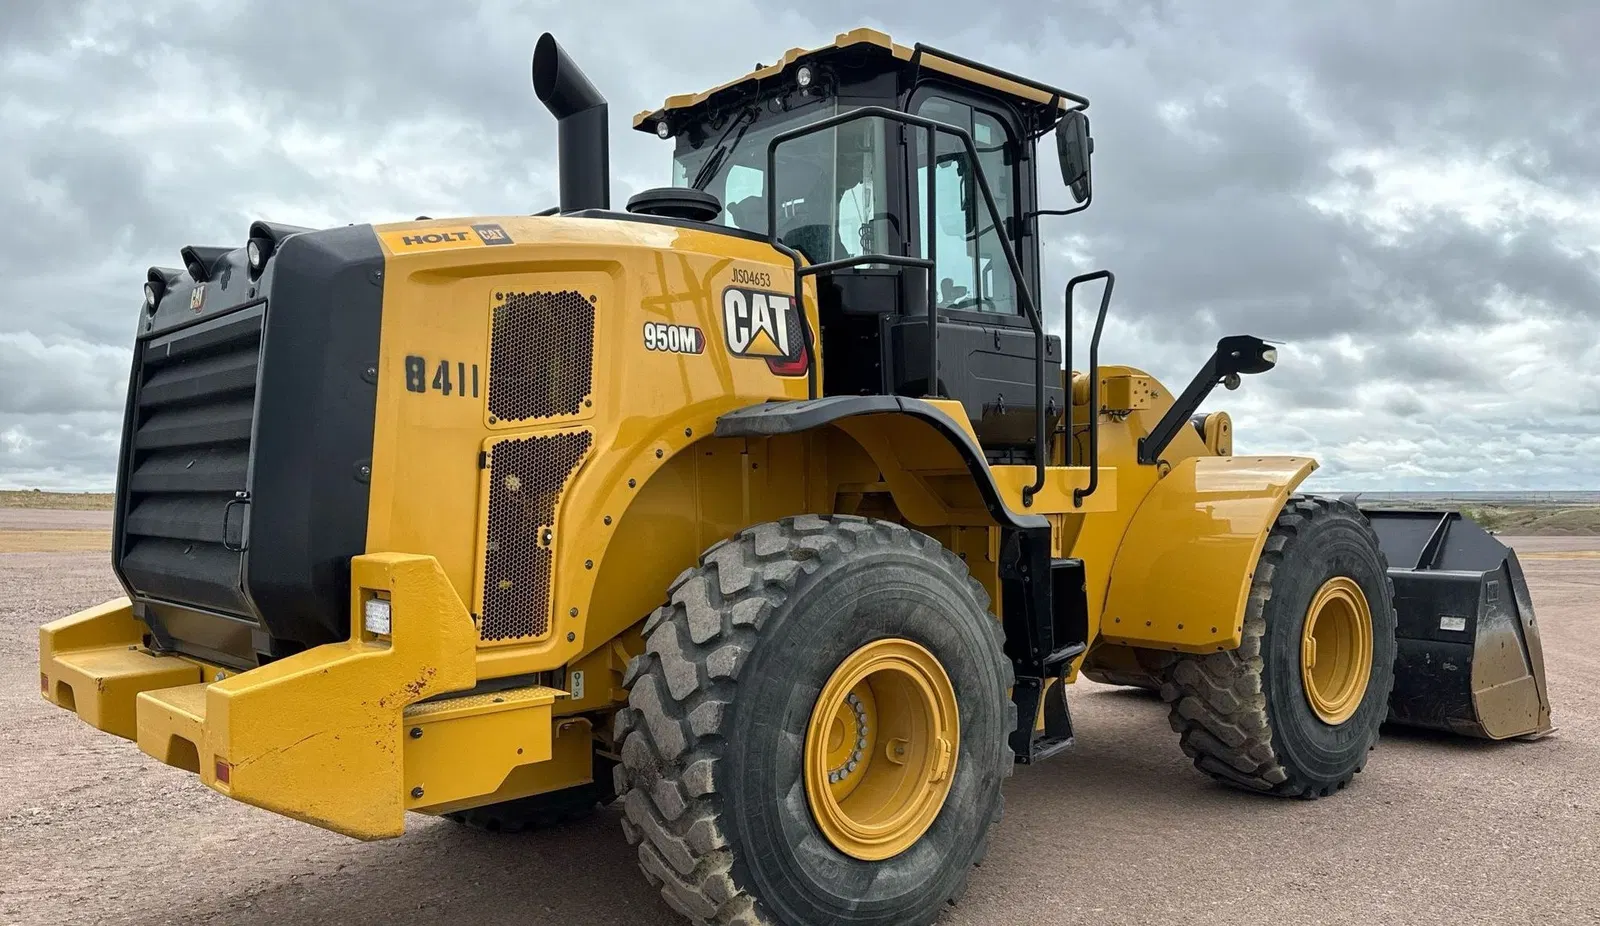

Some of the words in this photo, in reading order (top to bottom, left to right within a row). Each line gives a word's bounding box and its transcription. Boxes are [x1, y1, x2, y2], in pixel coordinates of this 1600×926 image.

[402, 231, 469, 245] HOLT
[480, 229, 504, 240] CAT
[190, 285, 205, 310] CAT
[644, 323, 697, 353] 950M
[724, 289, 791, 357] CAT
[405, 355, 479, 398] 8411
